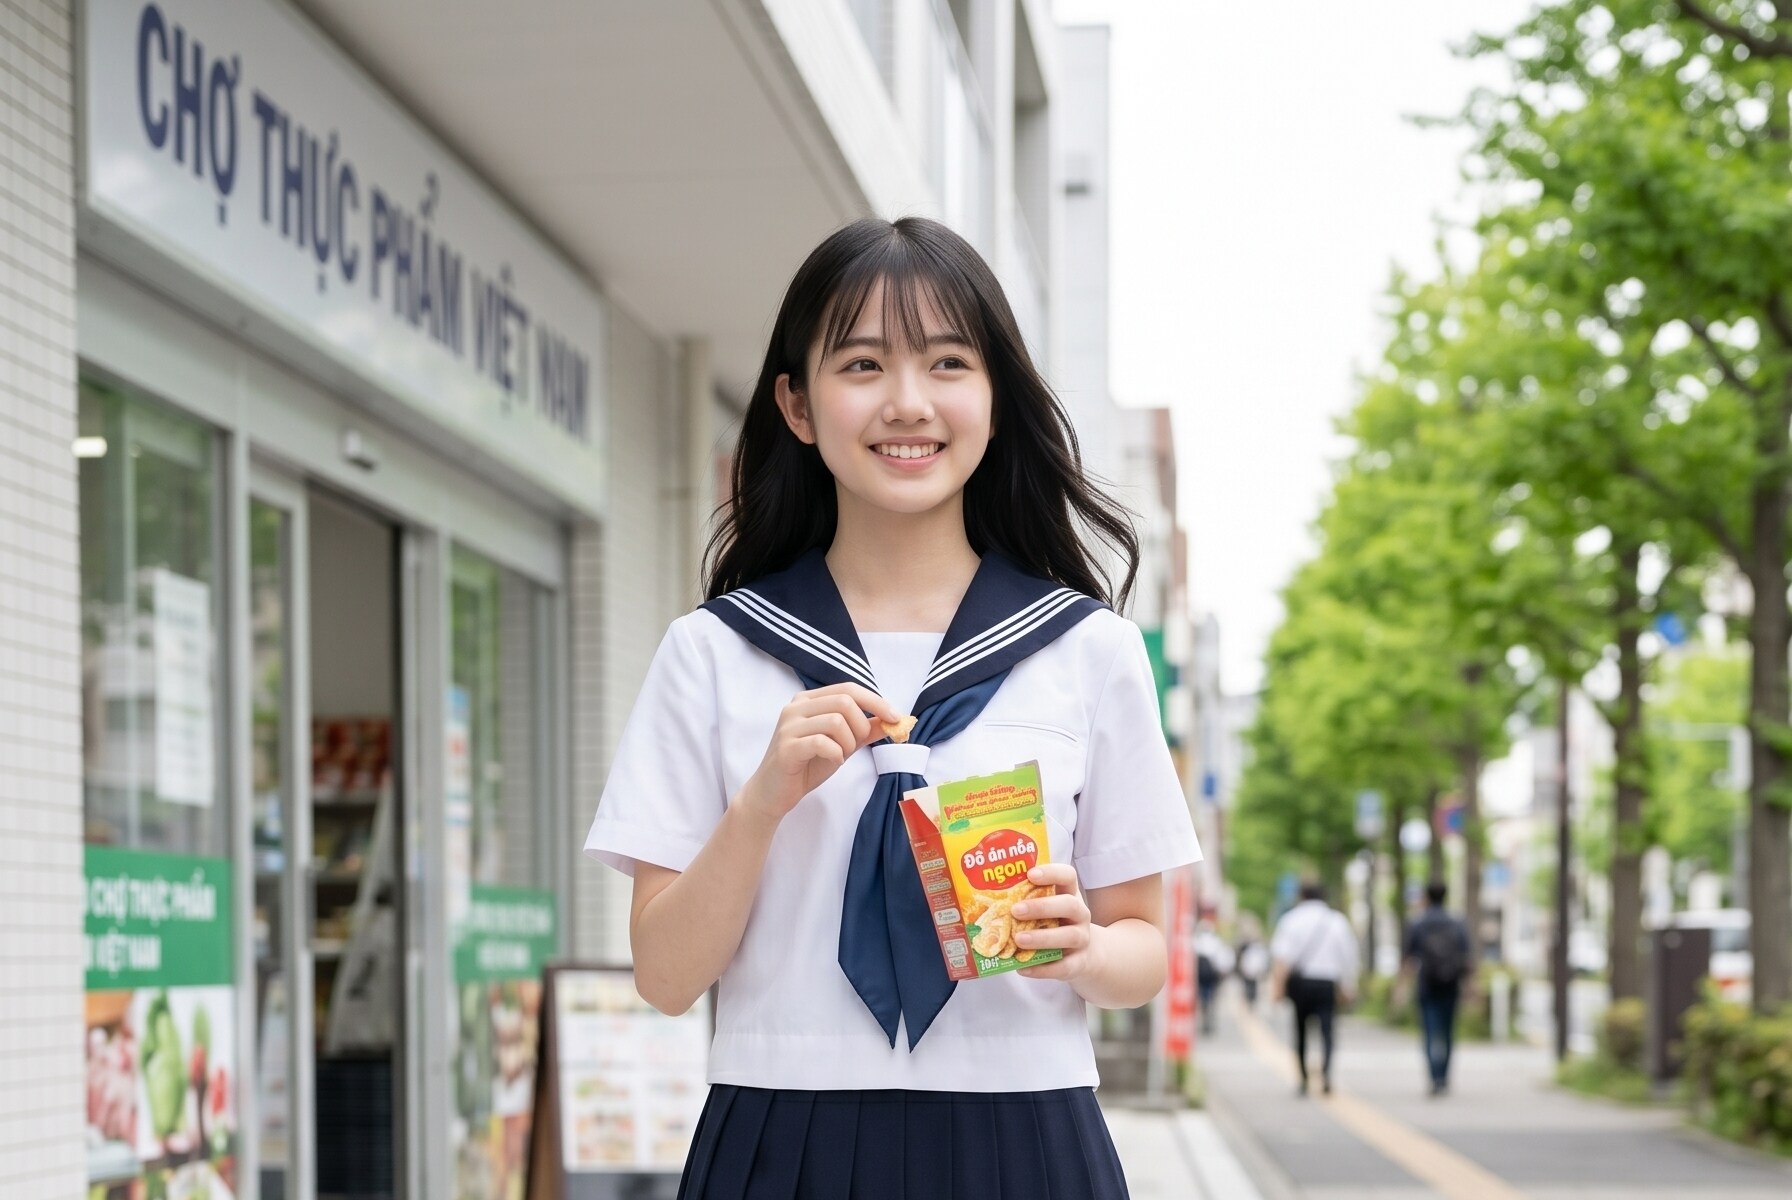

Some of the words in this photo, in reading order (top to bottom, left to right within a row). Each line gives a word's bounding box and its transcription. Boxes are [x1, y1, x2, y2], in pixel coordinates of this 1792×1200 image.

[137, 3, 241, 228] CHỢ
[252, 88, 359, 293] THỰC
[369, 171, 464, 361] PHẨM
[470, 261, 531, 414] VIỆT
[536, 321, 590, 446] NAM
[983, 860, 1027, 883] ngon
